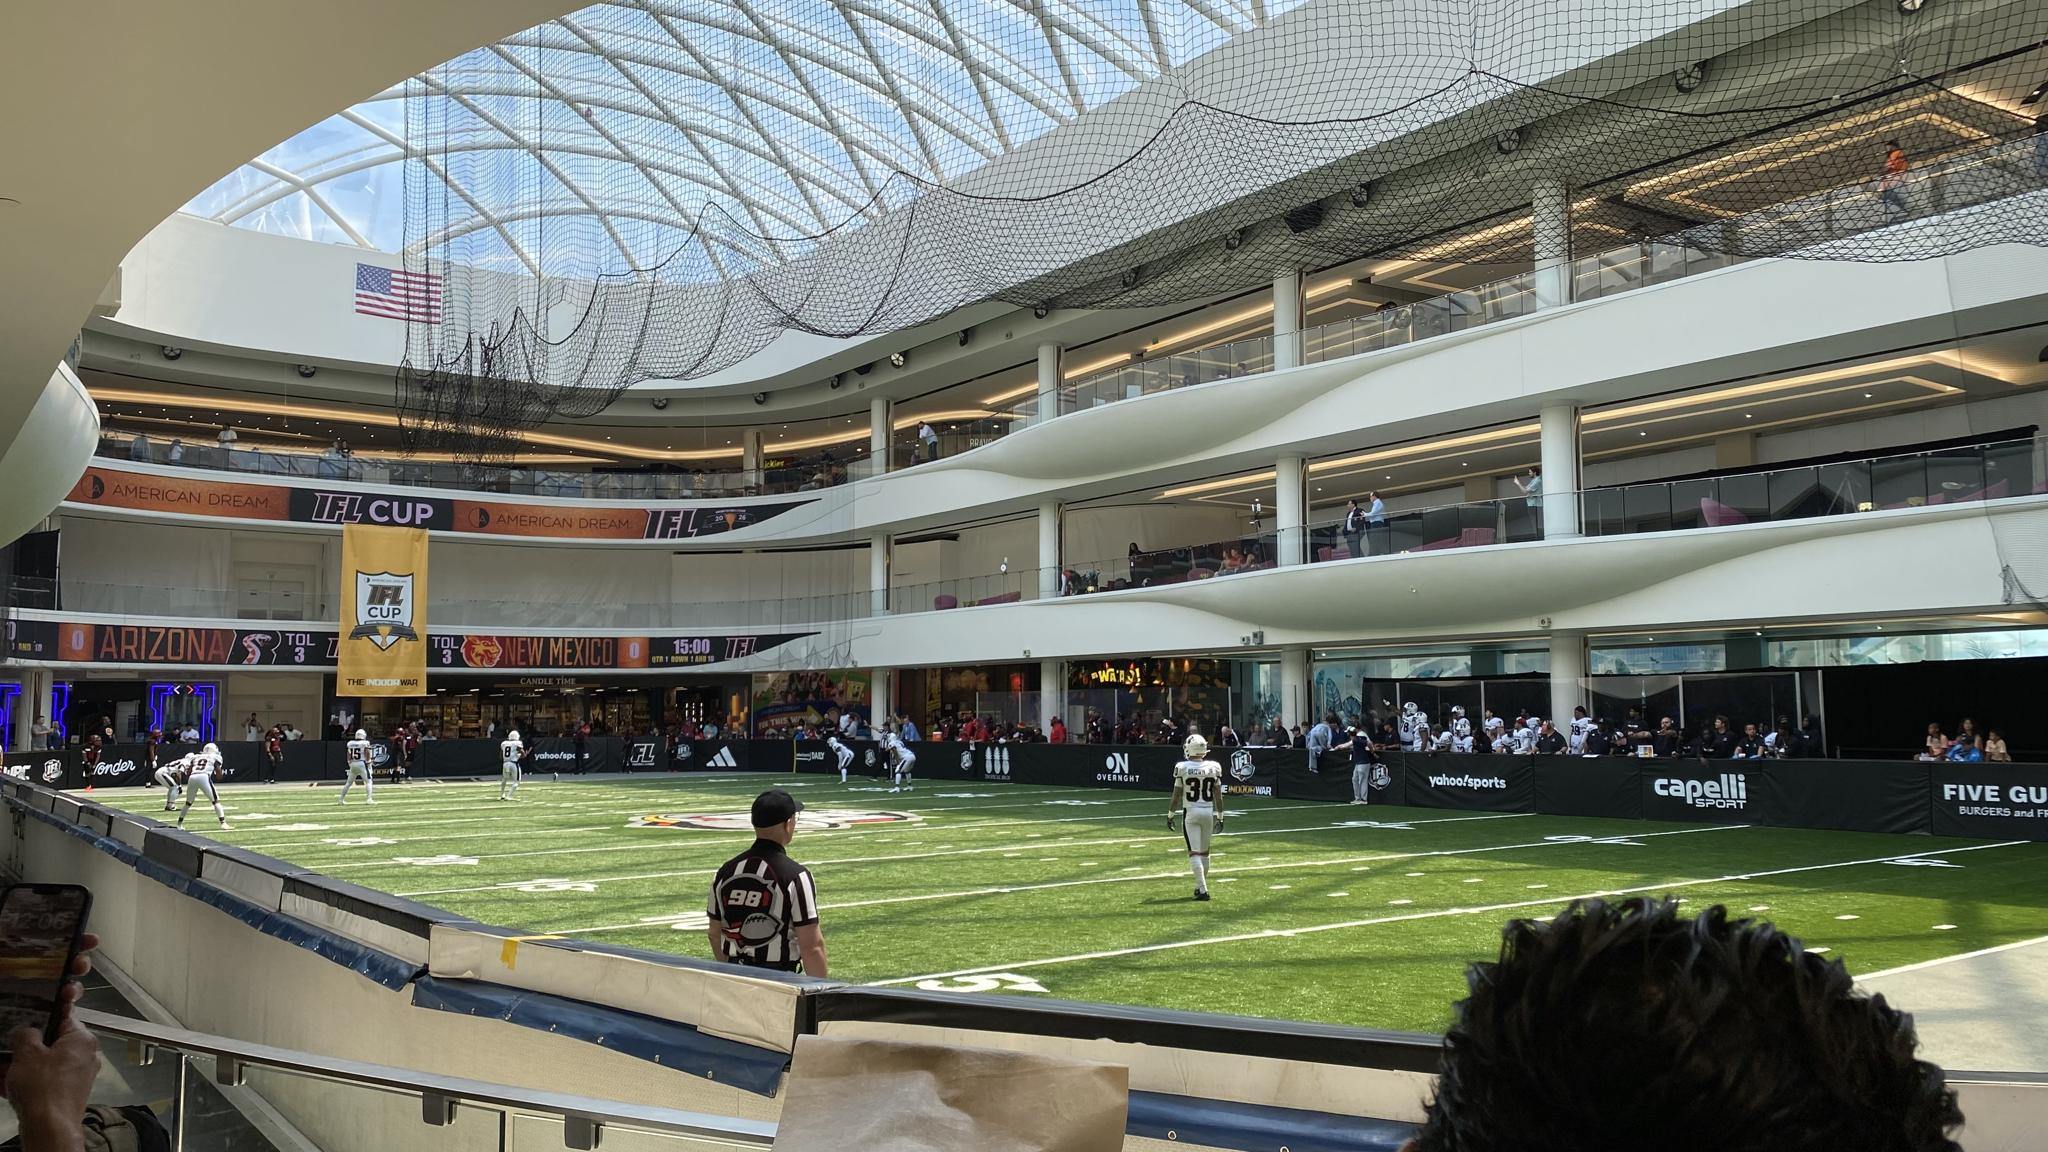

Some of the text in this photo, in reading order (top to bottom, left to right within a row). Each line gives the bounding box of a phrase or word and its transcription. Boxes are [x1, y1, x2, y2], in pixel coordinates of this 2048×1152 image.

[113, 484, 201, 504] AMERICAN
[312, 492, 434, 524] IFL CUP
[497, 514, 573, 529] AMERICAN
[643, 508, 698, 540] IFL
[367, 584, 404, 606] IFL
[368, 606, 401, 618] CUP
[72, 630, 84, 650] 0
[100, 625, 226, 662] ARIZONA
[286, 633, 315, 646] TOL
[432, 636, 459, 649] TOL
[672, 638, 710, 654] 15:00
[294, 646, 305, 663] 3
[505, 637, 613, 667] NEW MEXICO
[629, 642, 639, 659] 0
[725, 637, 757, 660] IFL
[442, 649, 452, 665] 3
[346, 678, 366, 686] THE
[400, 678, 418, 688] WAR
[520, 676, 576, 685] CANDLE TIME
[504, 746, 512, 758] 8
[811, 752, 825, 760] DAILY
[195, 758, 208, 771] 9
[1096, 773, 1140, 783] OVERNGHT
[1428, 773, 1507, 790] yahoo!sports
[1186, 777, 1217, 802] 30
[1255, 785, 1272, 796] WAR
[1654, 773, 1747, 804] capelli
[1943, 784, 2001, 802] FIVE
[1695, 798, 1747, 809] SPORT
[1959, 805, 2011, 817] BURGERS
[2013, 808, 2034, 818] and
[727, 889, 762, 908] 98
